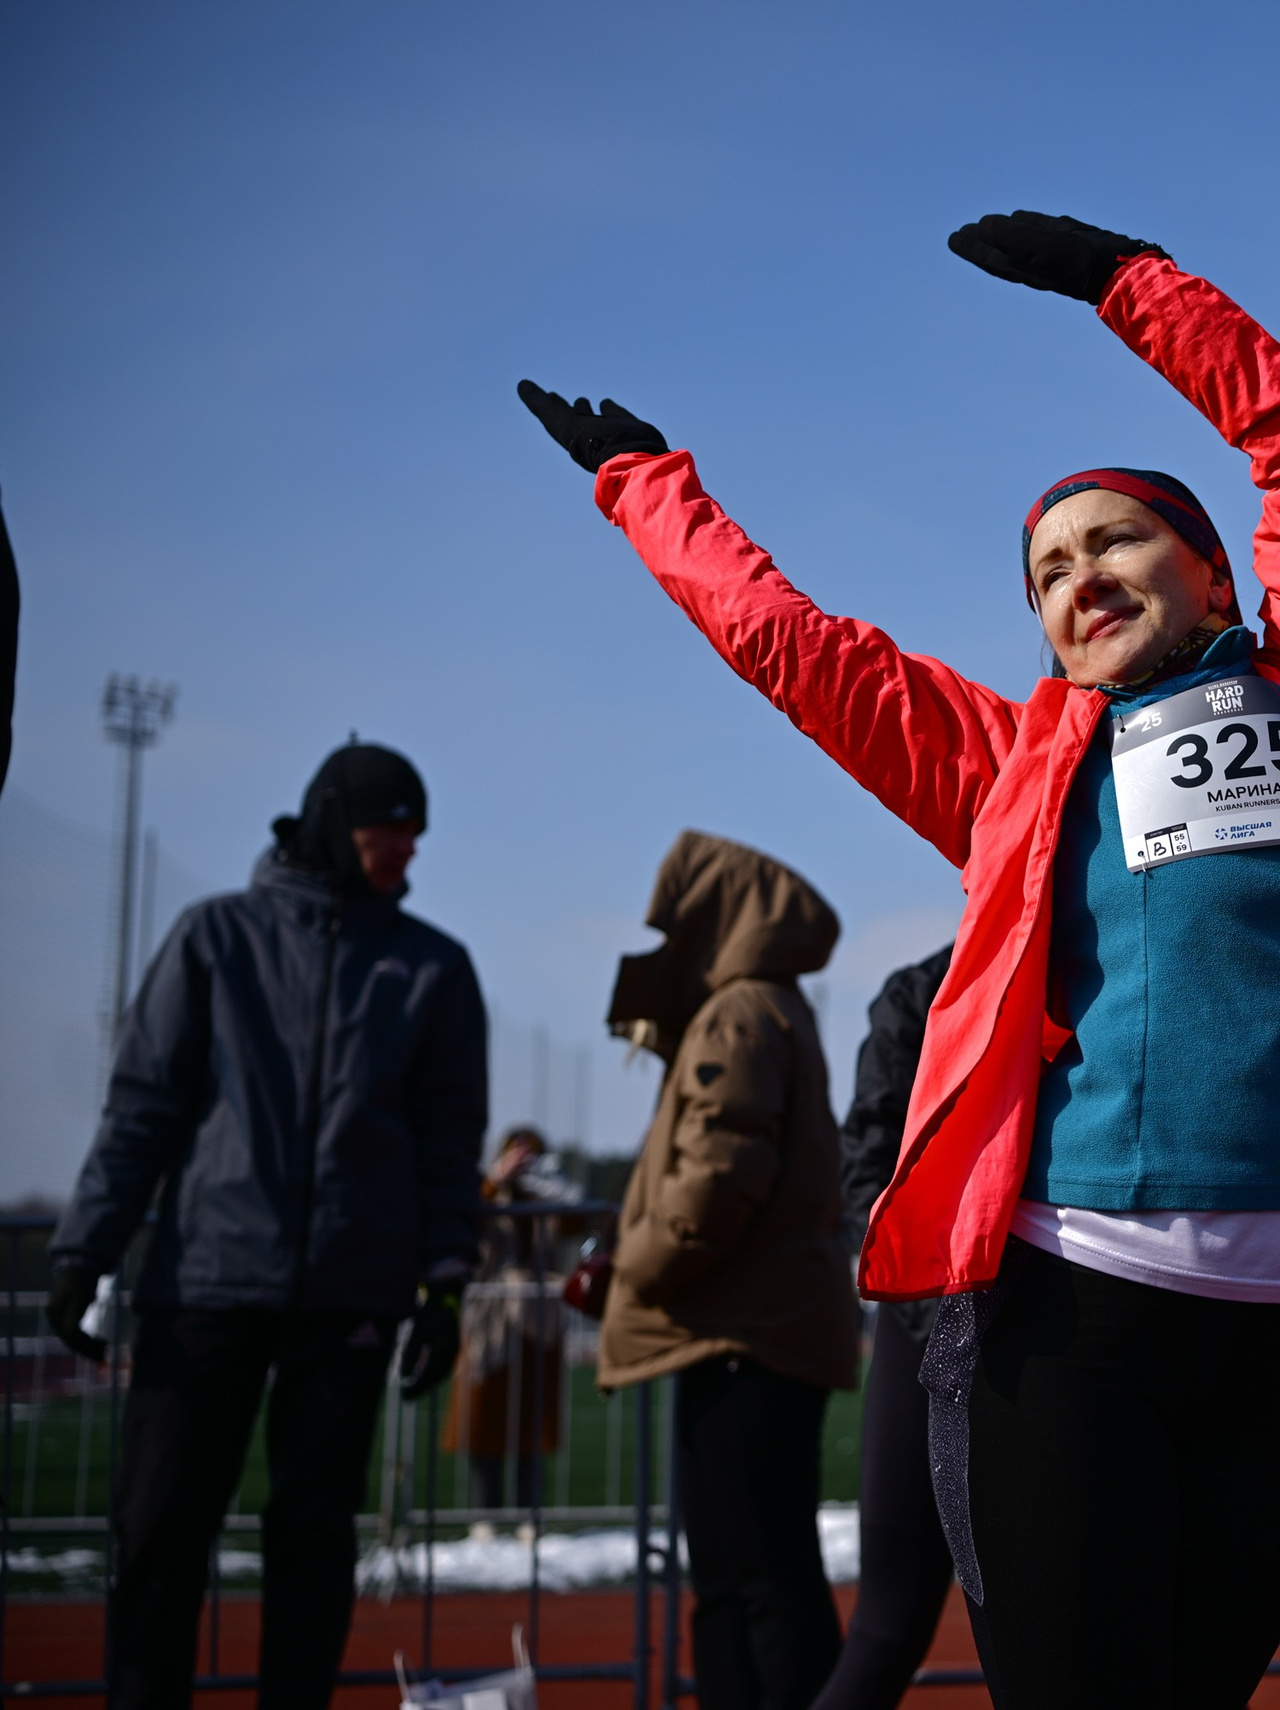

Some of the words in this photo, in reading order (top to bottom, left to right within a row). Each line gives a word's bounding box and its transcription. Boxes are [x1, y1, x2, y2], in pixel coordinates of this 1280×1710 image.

[1205, 685, 1244, 702] HARD
[1211, 696, 1243, 712] RUN
[1215, 803, 1243, 812] KUBAN
[1244, 798, 1280, 808] RUNNERS
[1230, 821, 1272, 832] ВЫСШАЯ
[1174, 833, 1185, 841] 55
[1230, 830, 1256, 839] ЛИГА
[1176, 844, 1187, 852] 59
